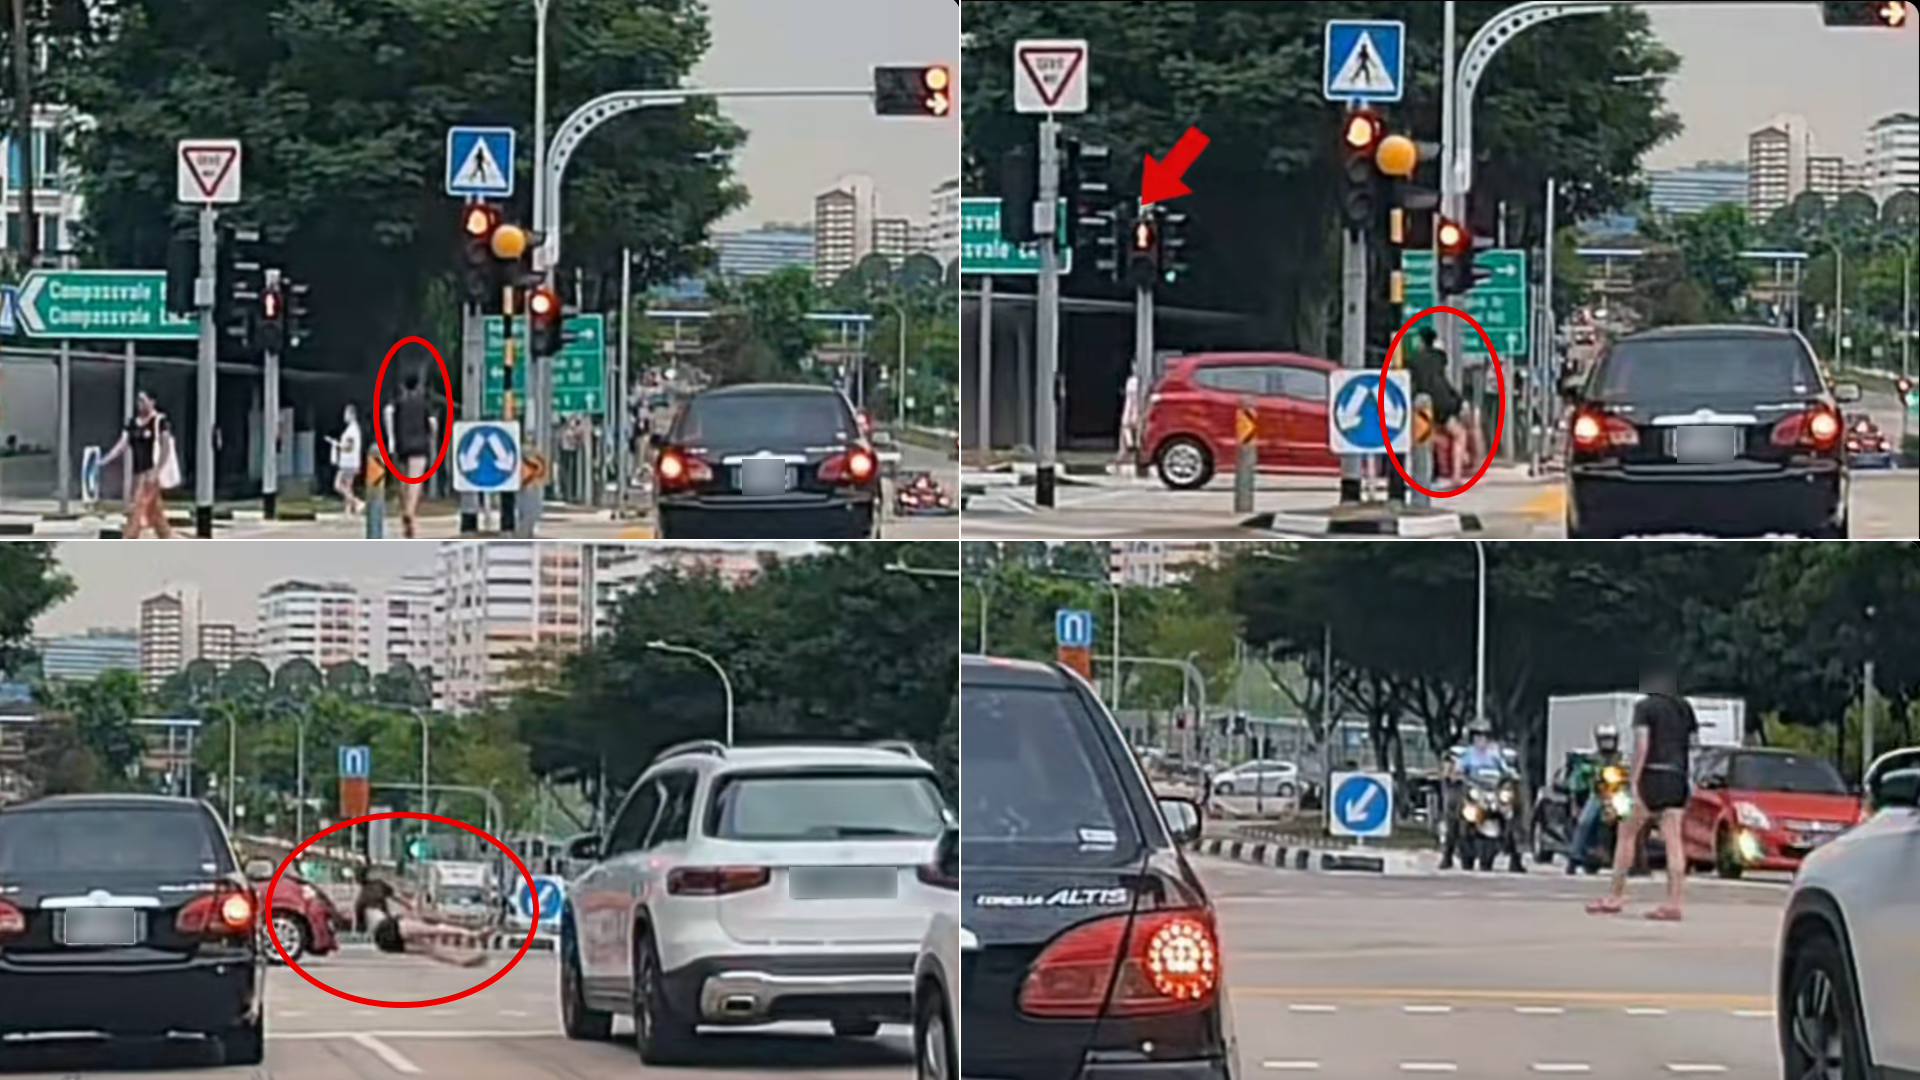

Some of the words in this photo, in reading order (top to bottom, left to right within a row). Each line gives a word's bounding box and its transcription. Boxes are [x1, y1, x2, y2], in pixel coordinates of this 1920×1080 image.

[49, 281, 150, 304] Compassvale
[49, 306, 150, 330] Compassvale
[1046, 887, 1127, 906] ALTIS
